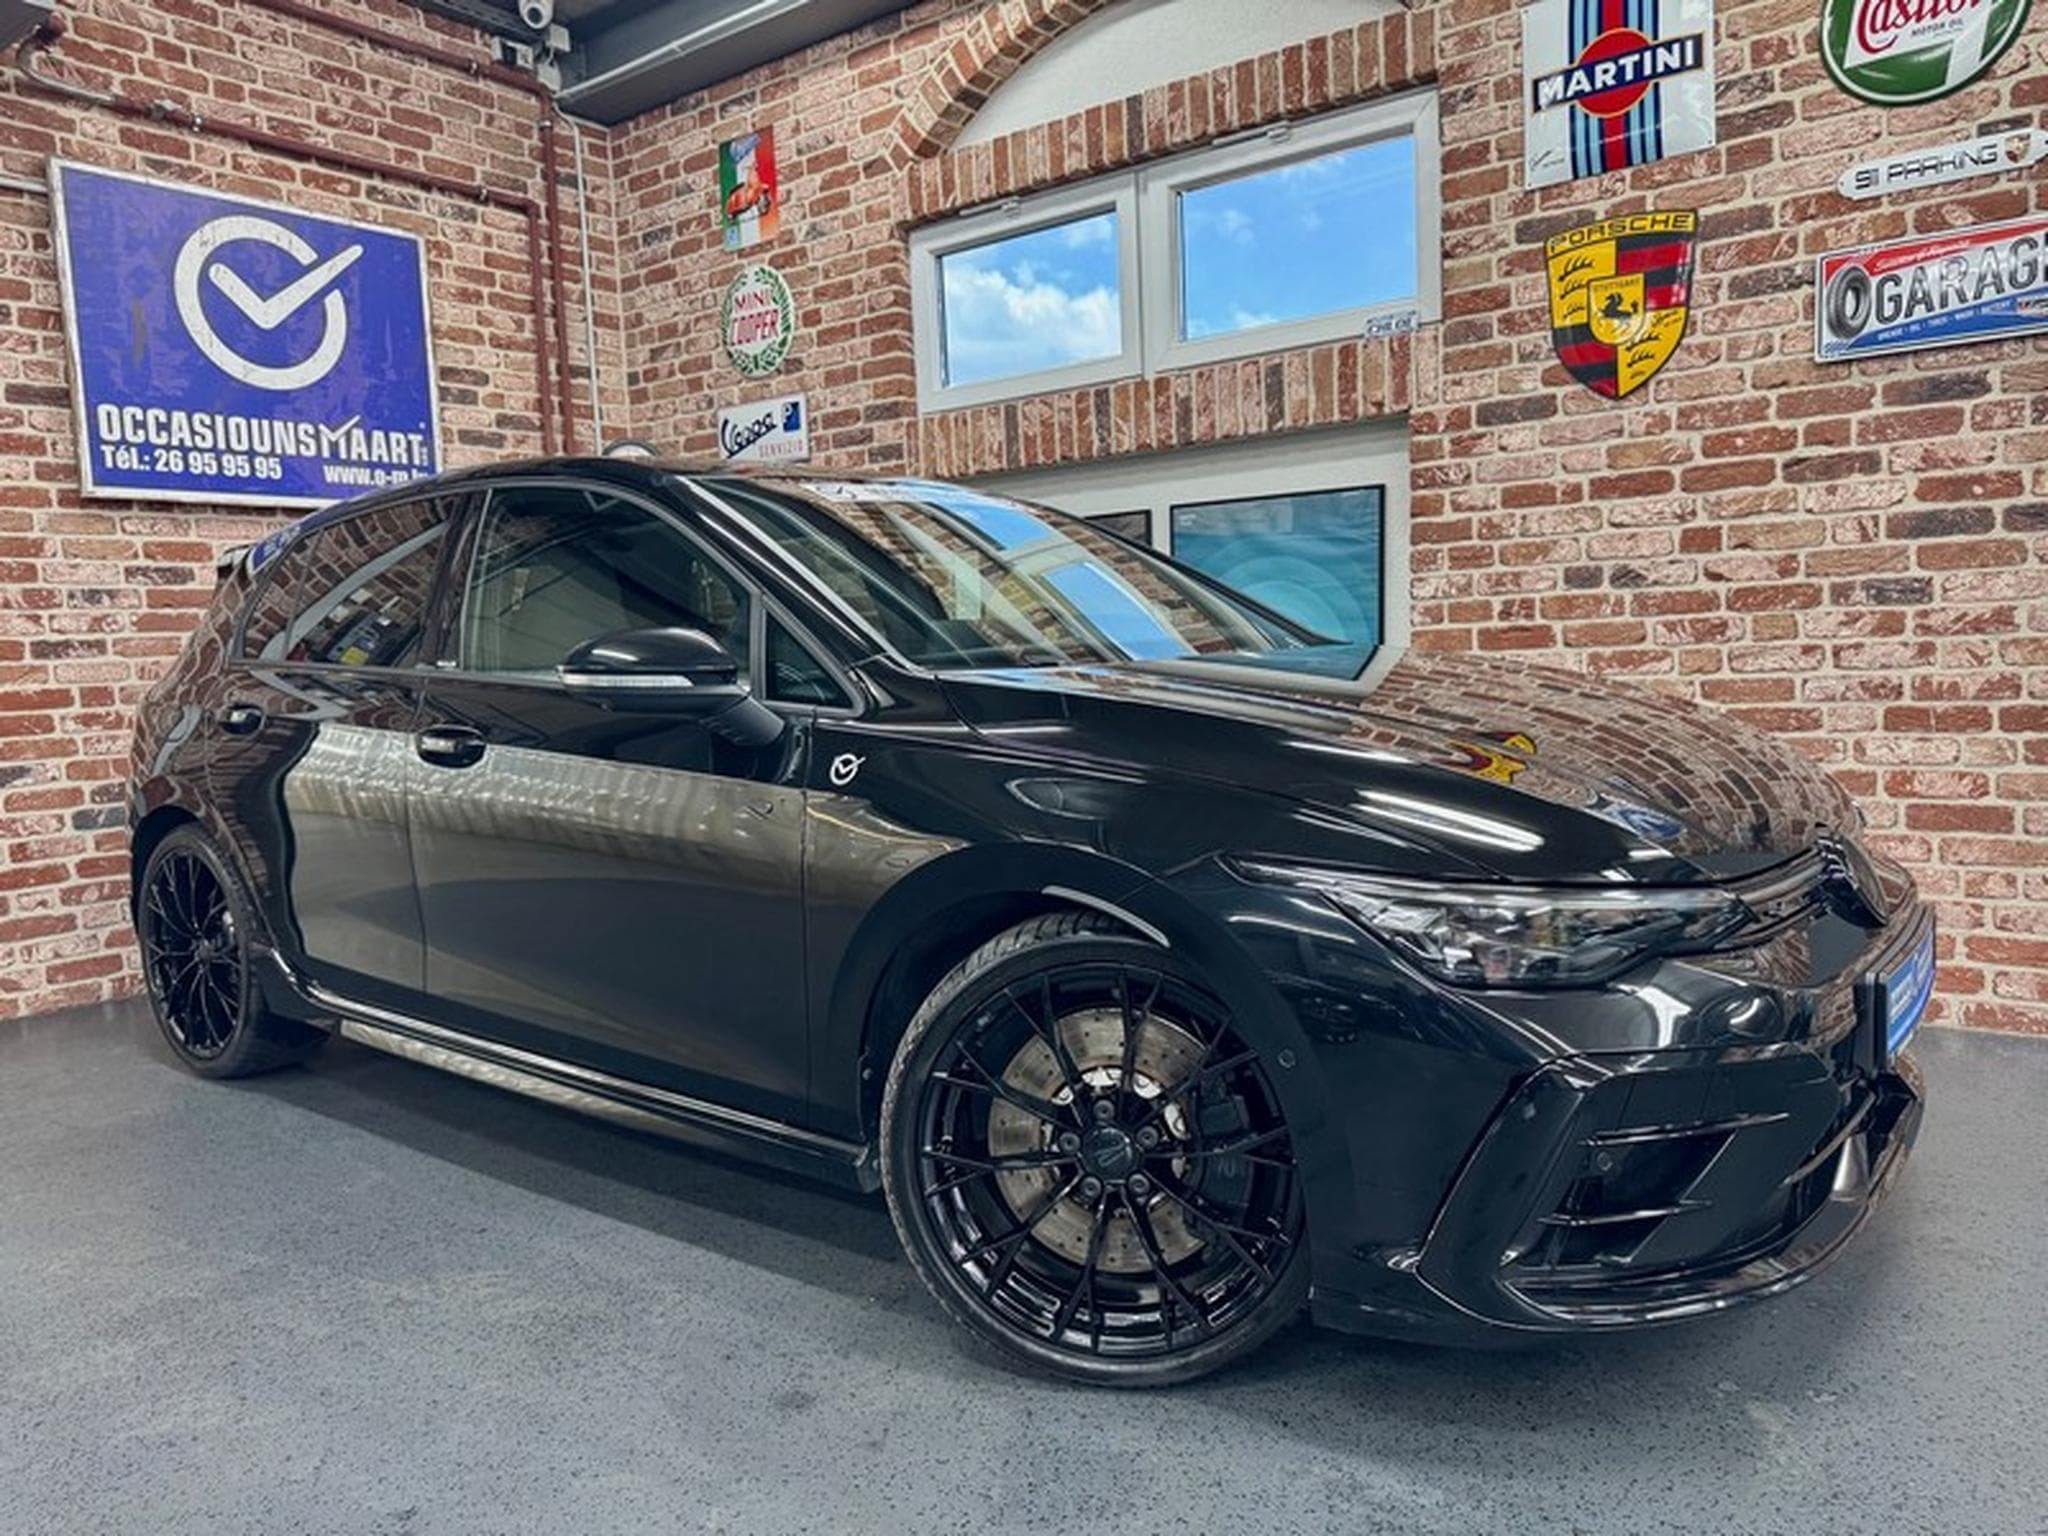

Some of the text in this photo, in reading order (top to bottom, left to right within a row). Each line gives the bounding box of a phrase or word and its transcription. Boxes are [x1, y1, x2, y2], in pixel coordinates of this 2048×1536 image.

[1538, 39, 1694, 109] MARTINI
[1887, 144, 1998, 183] PARKING
[1551, 214, 1690, 253] PORSCHE
[1875, 231, 2048, 325] GARAG
[735, 288, 772, 312] MINI
[731, 309, 779, 346] COOPER
[97, 403, 424, 467] OCCASIOUNSMAART
[721, 410, 777, 459] Vespa
[101, 444, 283, 480] Tél.: 26 95 95 95
[322, 465, 428, 487] www.o-ml
